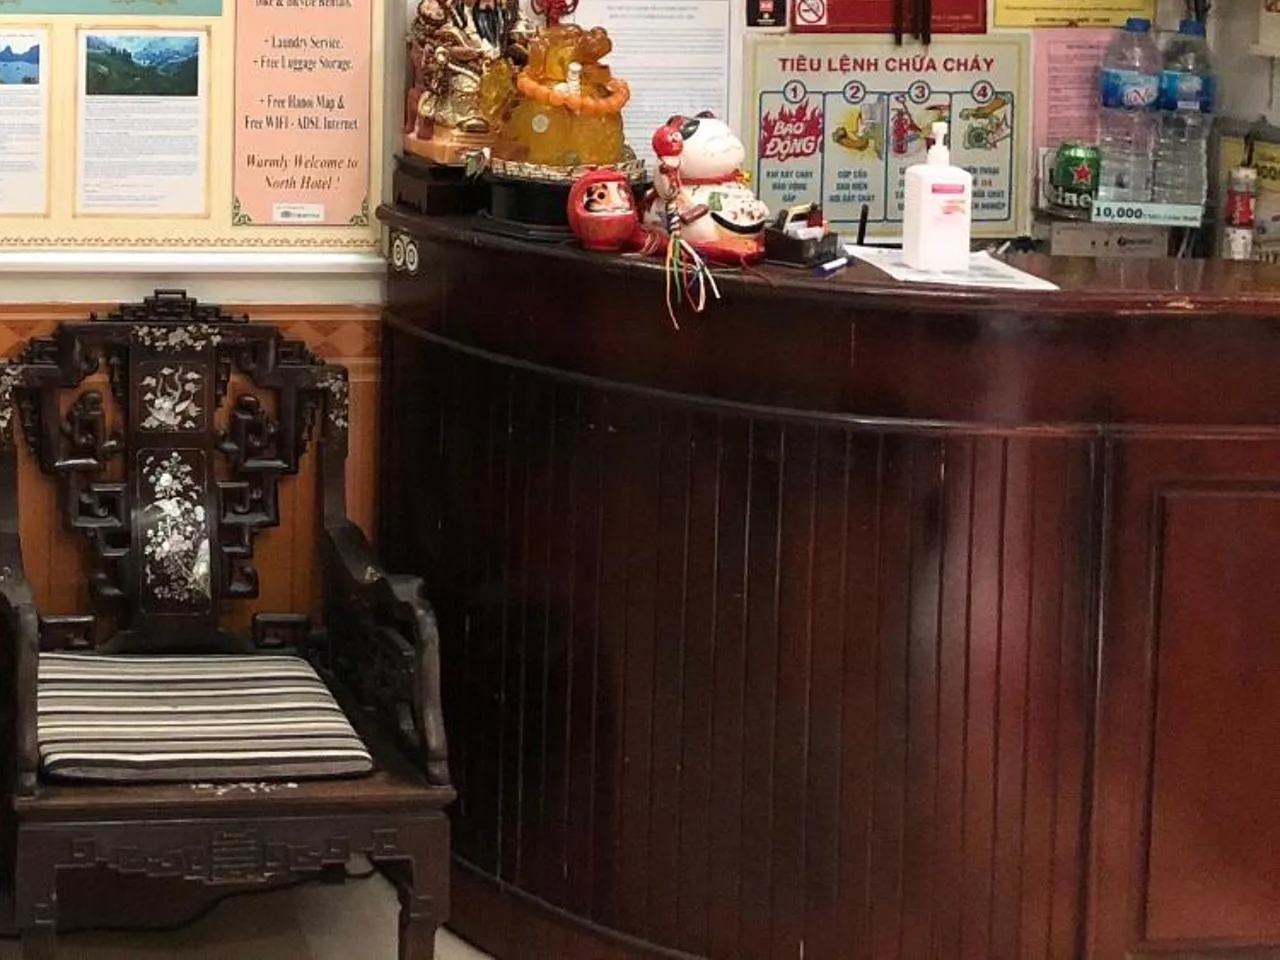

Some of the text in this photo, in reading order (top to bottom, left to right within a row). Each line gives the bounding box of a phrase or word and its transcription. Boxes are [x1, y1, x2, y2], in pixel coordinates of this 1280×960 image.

[827, 54, 879, 75] LỆNH
[943, 54, 995, 72] CHÁY
[789, 85, 799, 99] 1
[849, 85, 861, 99] 2
[914, 85, 927, 100] 3
[976, 85, 989, 100] 4
[1094, 205, 1144, 221] 10,000
